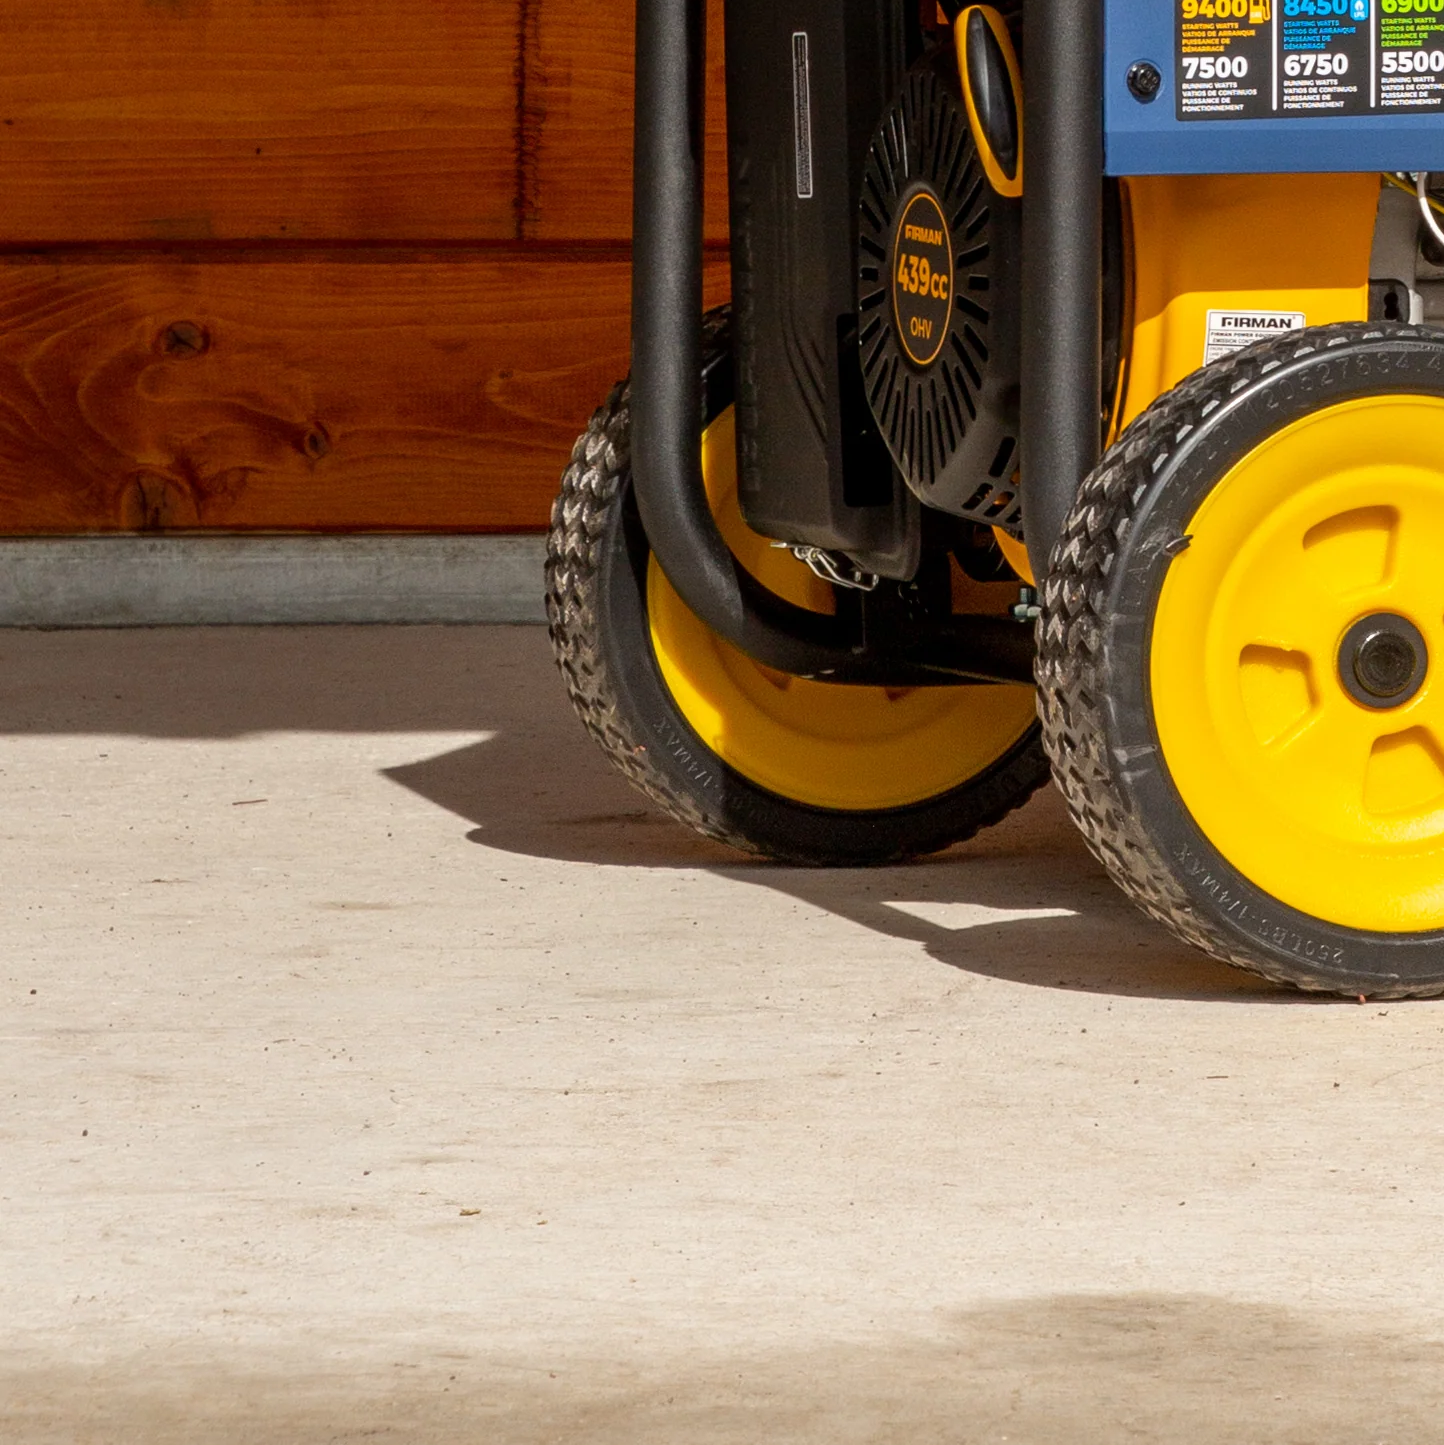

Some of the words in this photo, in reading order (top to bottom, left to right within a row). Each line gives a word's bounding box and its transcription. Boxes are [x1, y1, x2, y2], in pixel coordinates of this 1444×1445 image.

[1182, 56, 1248, 79] 7500
[1284, 53, 1349, 76] 6750
[1381, 51, 1444, 73] 5500
[905, 224, 942, 245] FIRMAN
[898, 254, 948, 300] 439cc
[910, 316, 932, 339] OHV
[1221, 316, 1292, 328] FIRMAN
